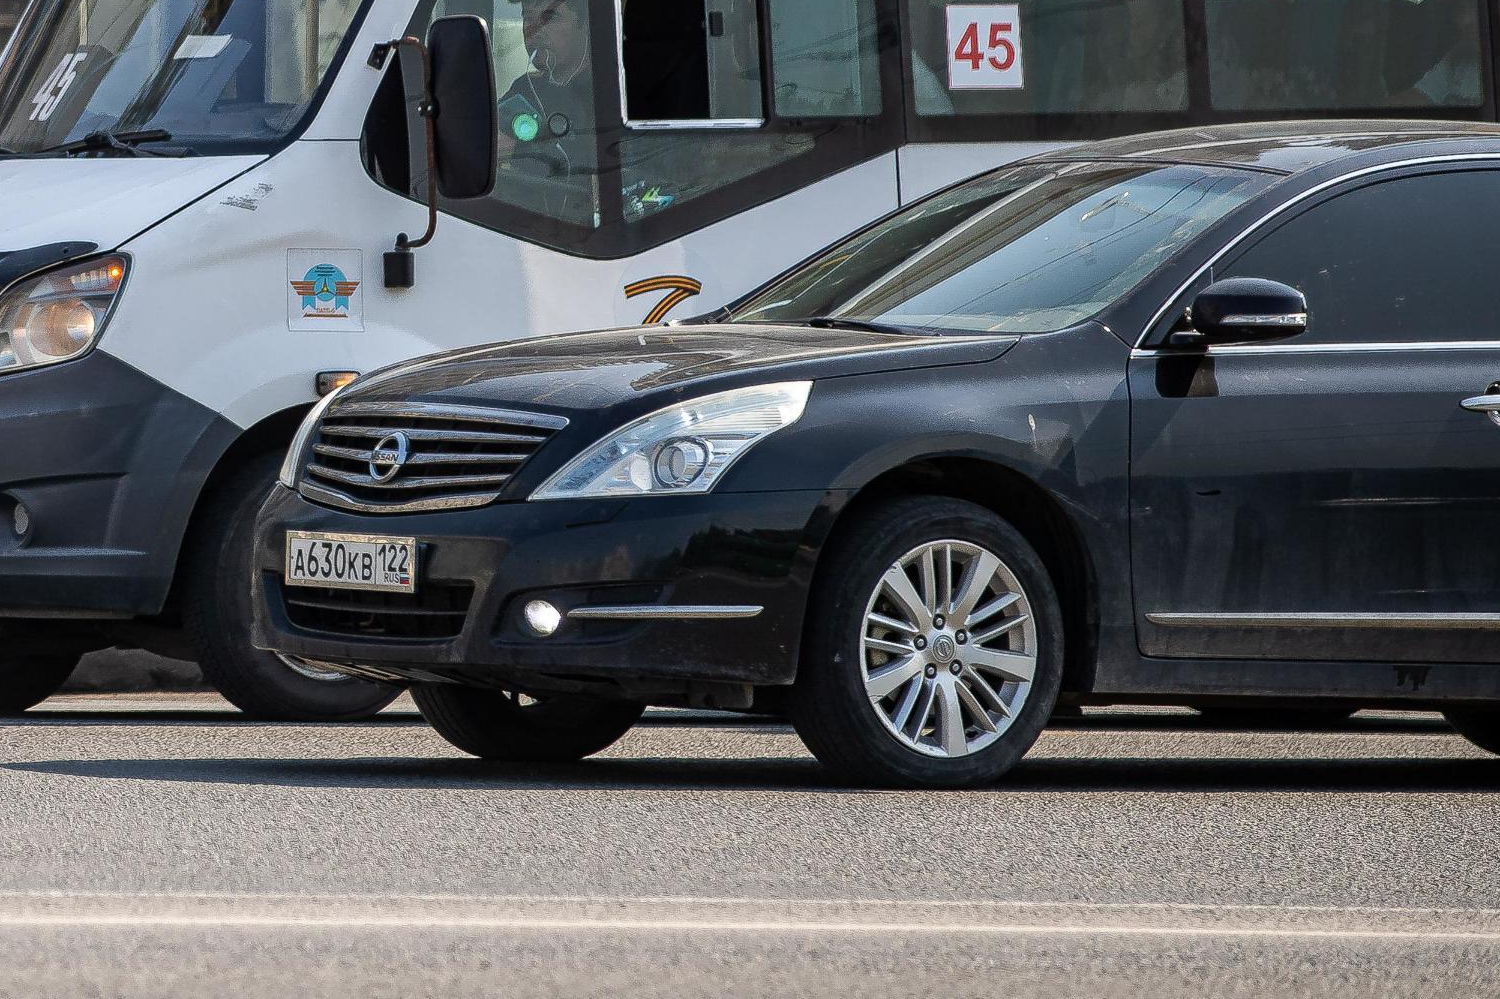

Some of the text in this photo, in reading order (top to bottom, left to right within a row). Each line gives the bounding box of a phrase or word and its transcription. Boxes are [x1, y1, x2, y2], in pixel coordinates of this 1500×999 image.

[954, 22, 1016, 70] 45
[29, 52, 88, 121] 45
[294, 541, 409, 581] А630КВ 122
[384, 572, 399, 583] RUS
